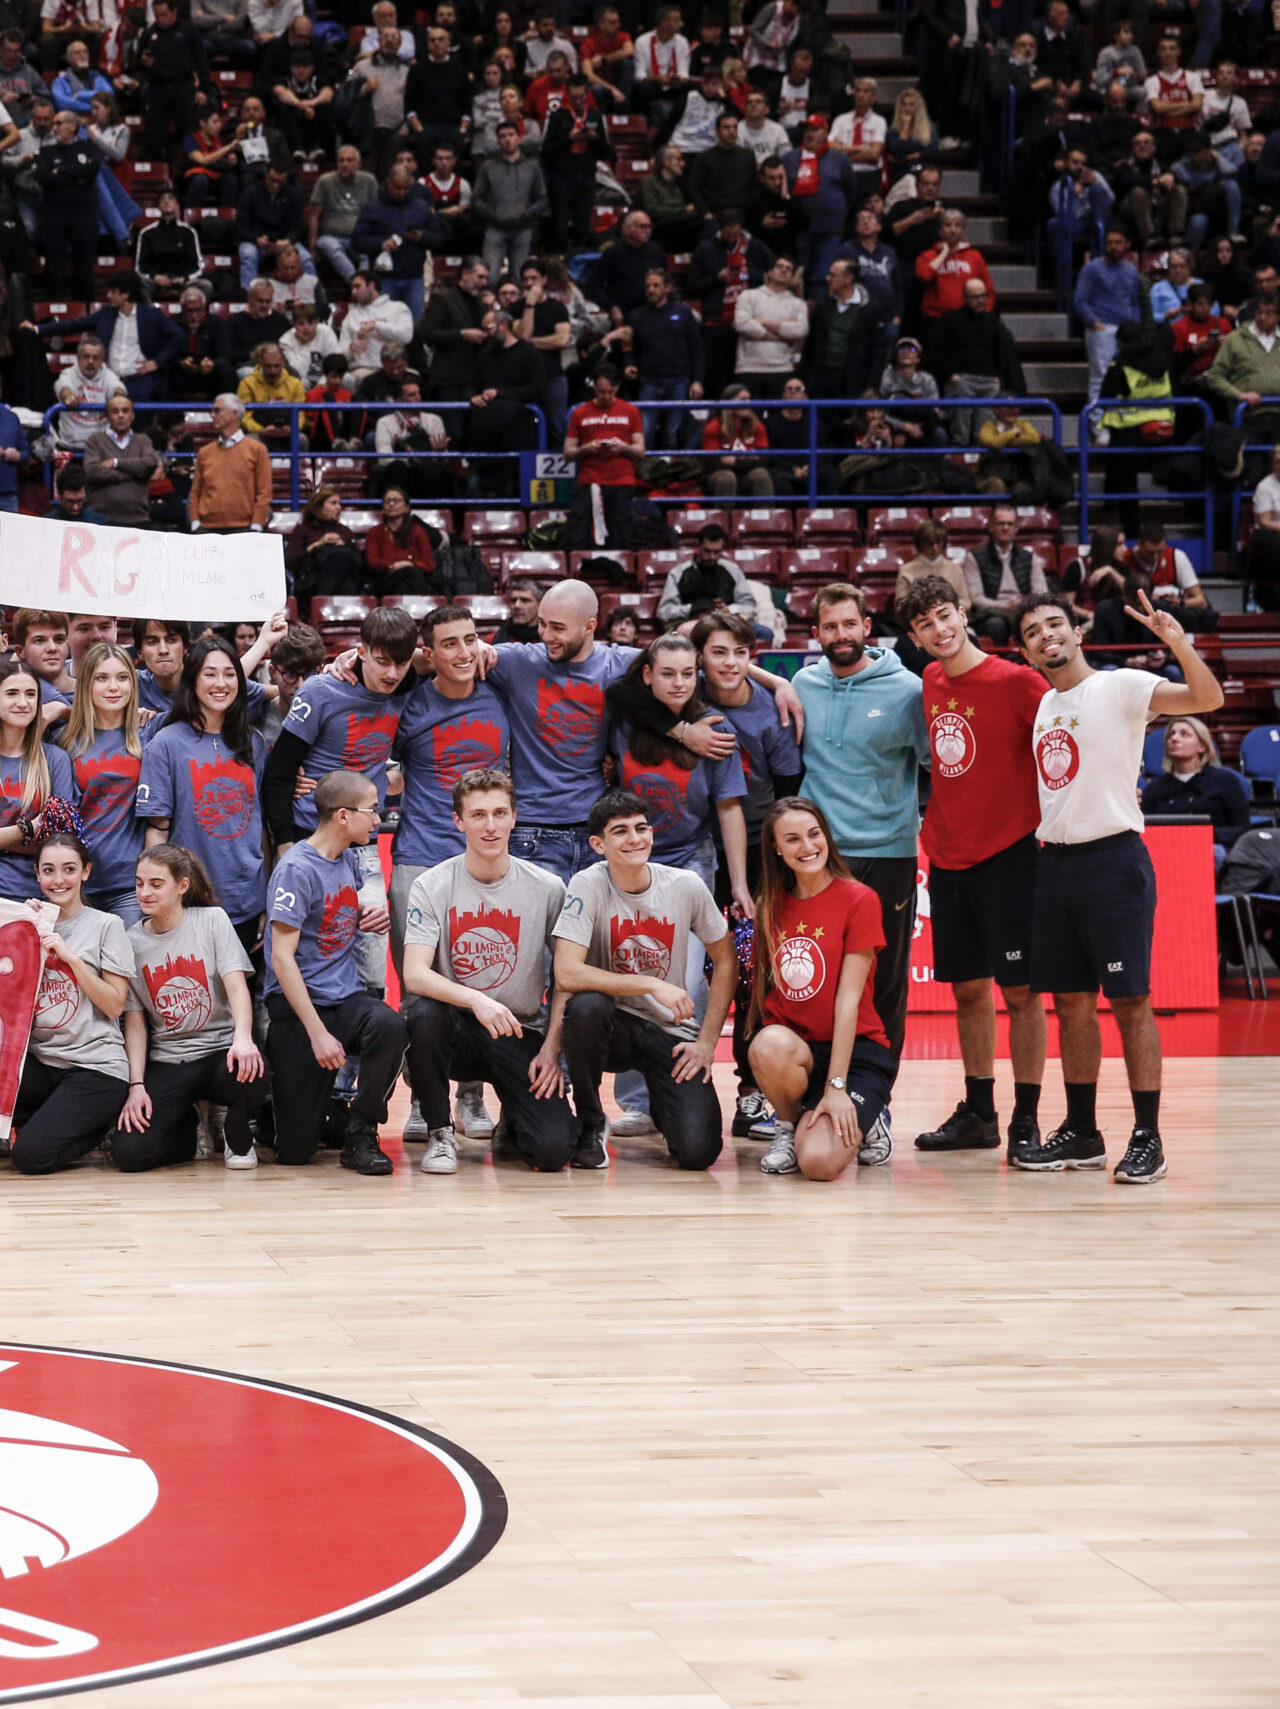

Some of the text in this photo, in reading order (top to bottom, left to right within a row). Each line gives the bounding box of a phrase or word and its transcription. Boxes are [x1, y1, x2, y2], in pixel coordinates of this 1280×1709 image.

[543, 457, 569, 475] 22
[936, 716, 964, 729] OLIMPIA
[1040, 730, 1069, 745] OLIMPIA
[938, 763, 964, 775] MILANO
[455, 941, 504, 955] OLIMPIA
[1006, 951, 1022, 960] EA7
[453, 953, 505, 975] SCHOOL
[1108, 962, 1124, 972] EA7
